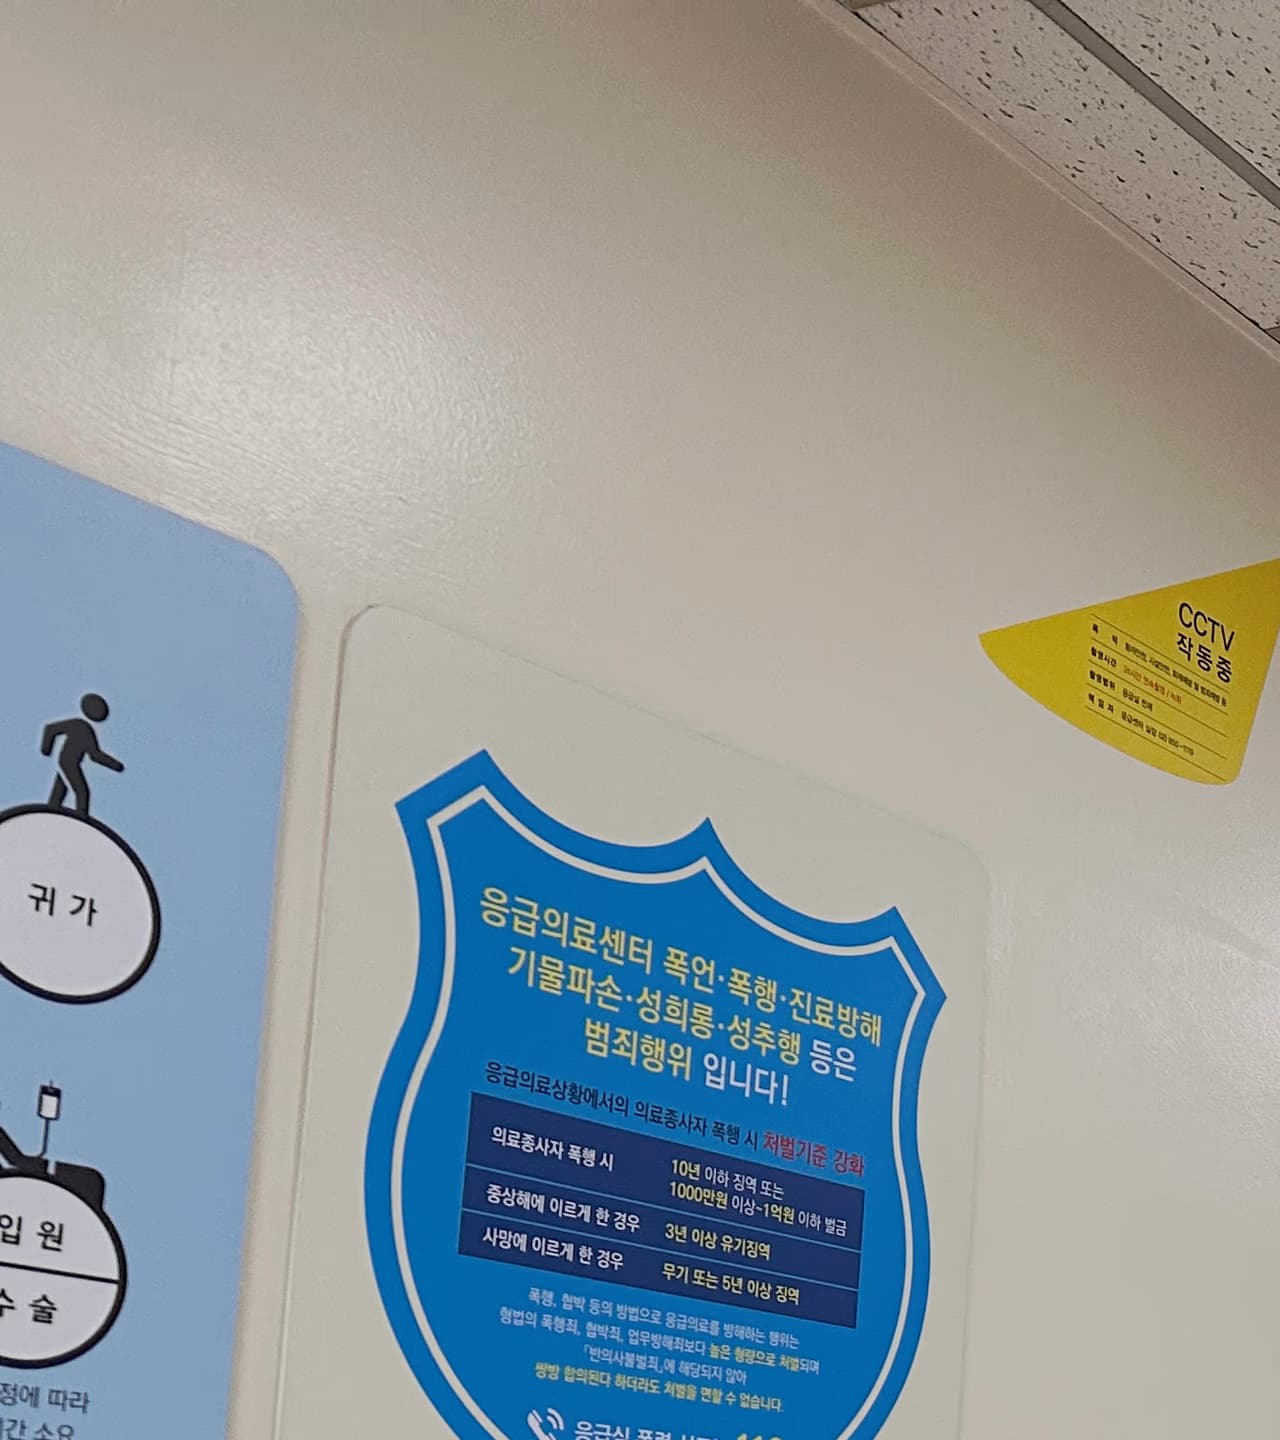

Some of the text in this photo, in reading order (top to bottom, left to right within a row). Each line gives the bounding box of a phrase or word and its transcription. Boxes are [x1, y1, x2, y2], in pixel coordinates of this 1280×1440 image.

[1178, 602, 1235, 652] CCTV
[480, 886, 654, 974] 응급의료센터
[584, 1018, 789, 1106] 범죄행위 입니다!
[809, 1039, 857, 1082] 등은
[486, 1061, 865, 1177] 응급의료상황에서의 의료종사자 폭행 시 처벌기준 강화
[491, 1126, 615, 1172] 의료종사자 폭행 시
[671, 1158, 785, 1199] 10년 이하 징역 또는
[486, 1184, 641, 1233] 중상해에 이르게 한 경우
[669, 1181, 848, 1237] 1000만원 이하 벌금
[482, 1226, 624, 1271] 사망에 이르게 한 경우
[664, 1223, 771, 1262] 3년 이상 유기징역
[662, 1263, 800, 1306] 무기 또는 5년 이상 징역
[499, 1306, 820, 1376] 형법의 업무방해죄보다 형량으로 처벌되며
[562, 1293, 799, 1350] 협박 등의 방법으로 응급의료를 방해하는 행위는
[563, 1366, 737, 1407] 합의된다 하더라도 처벌을 수
[678, 1359, 723, 1383] 해당되지
[725, 1365, 747, 1385] 않아
[48, 1389, 89, 1414] 따라
